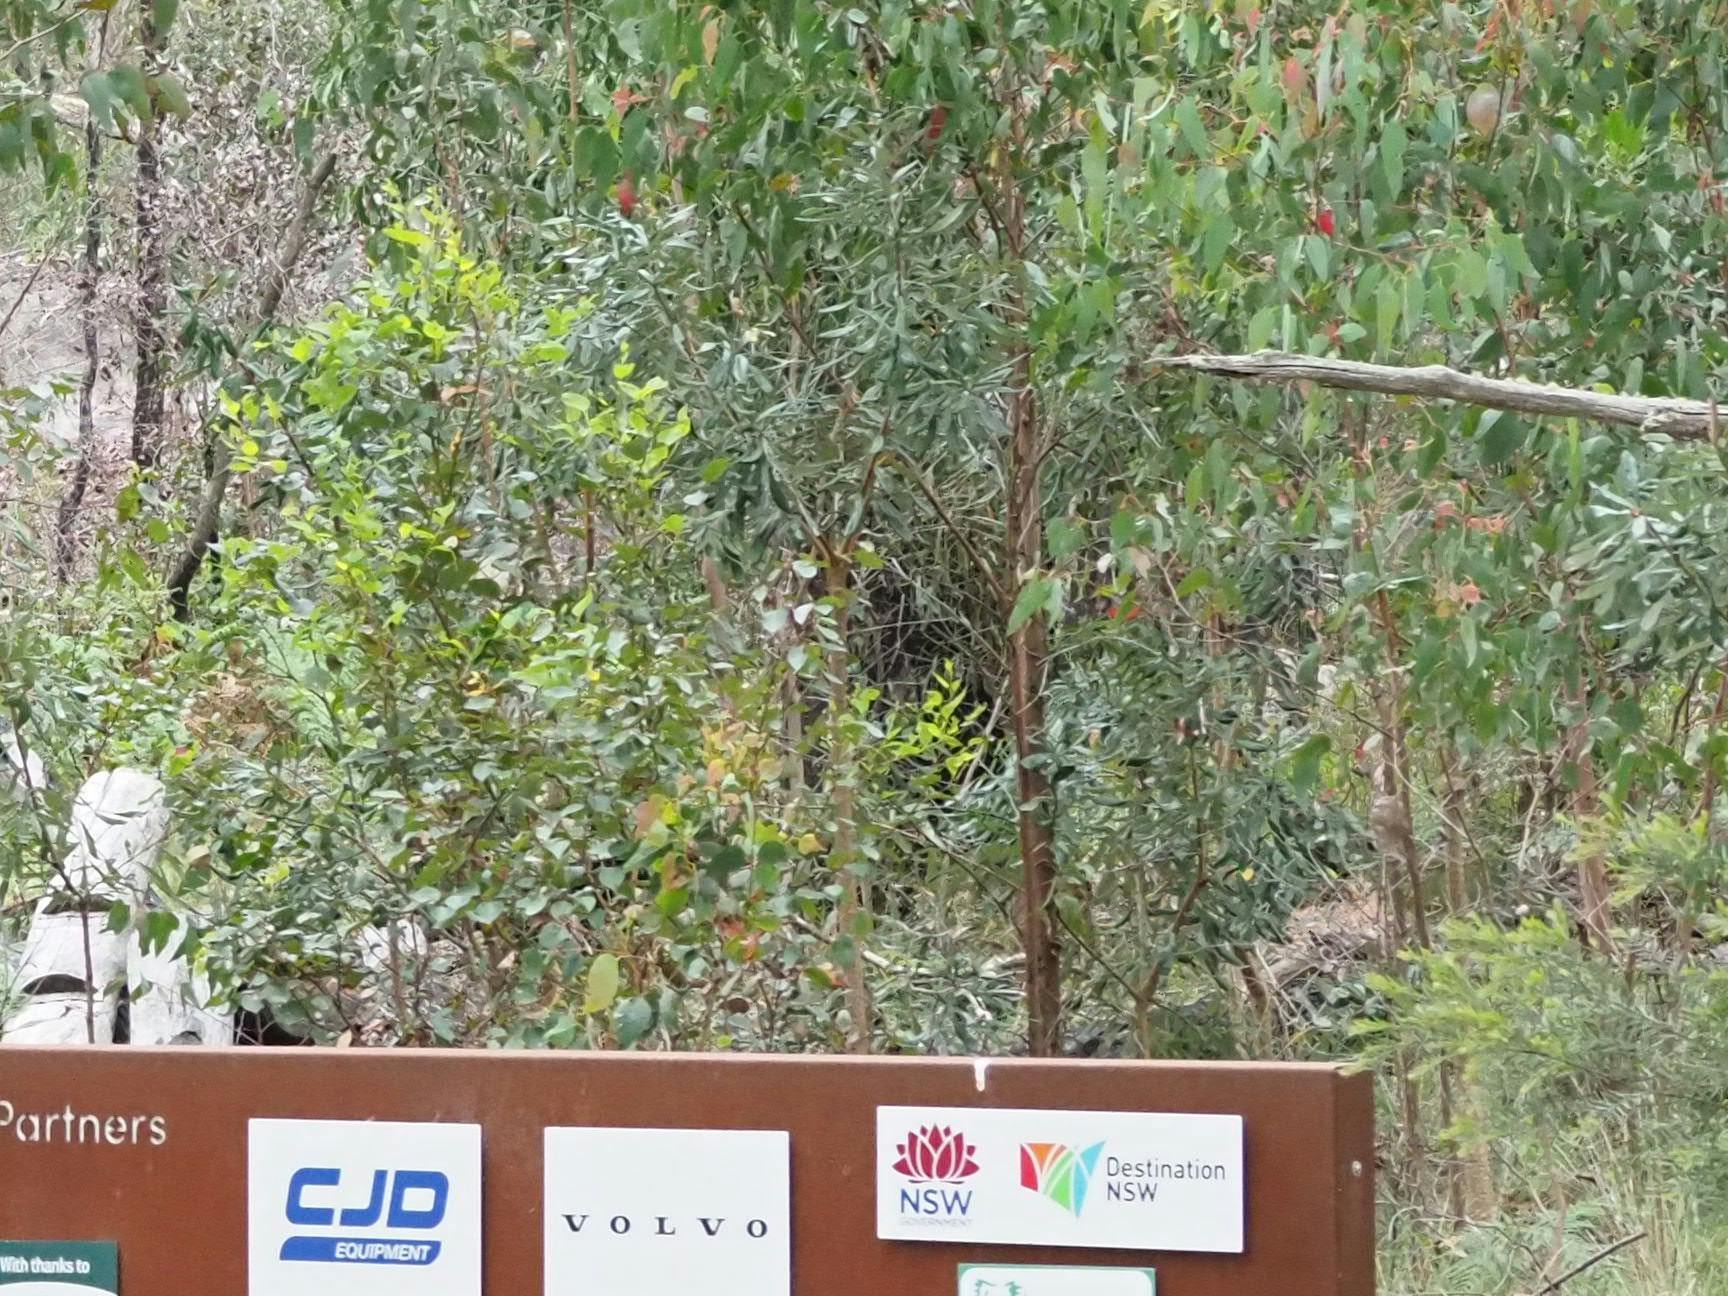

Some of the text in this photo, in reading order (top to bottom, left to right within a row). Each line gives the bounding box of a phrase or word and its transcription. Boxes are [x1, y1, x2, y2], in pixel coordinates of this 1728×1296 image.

[1106, 1156, 1226, 1181] Destination
[285, 1167, 449, 1230] CJD
[900, 1188, 973, 1216] NSW
[1106, 1182, 1158, 1202] NSW
[561, 1213, 769, 1239] VOLVO
[30, 1256, 75, 1274] thanks
[76, 1259, 91, 1274] to
[334, 1242, 431, 1263] EQUIPMENT
